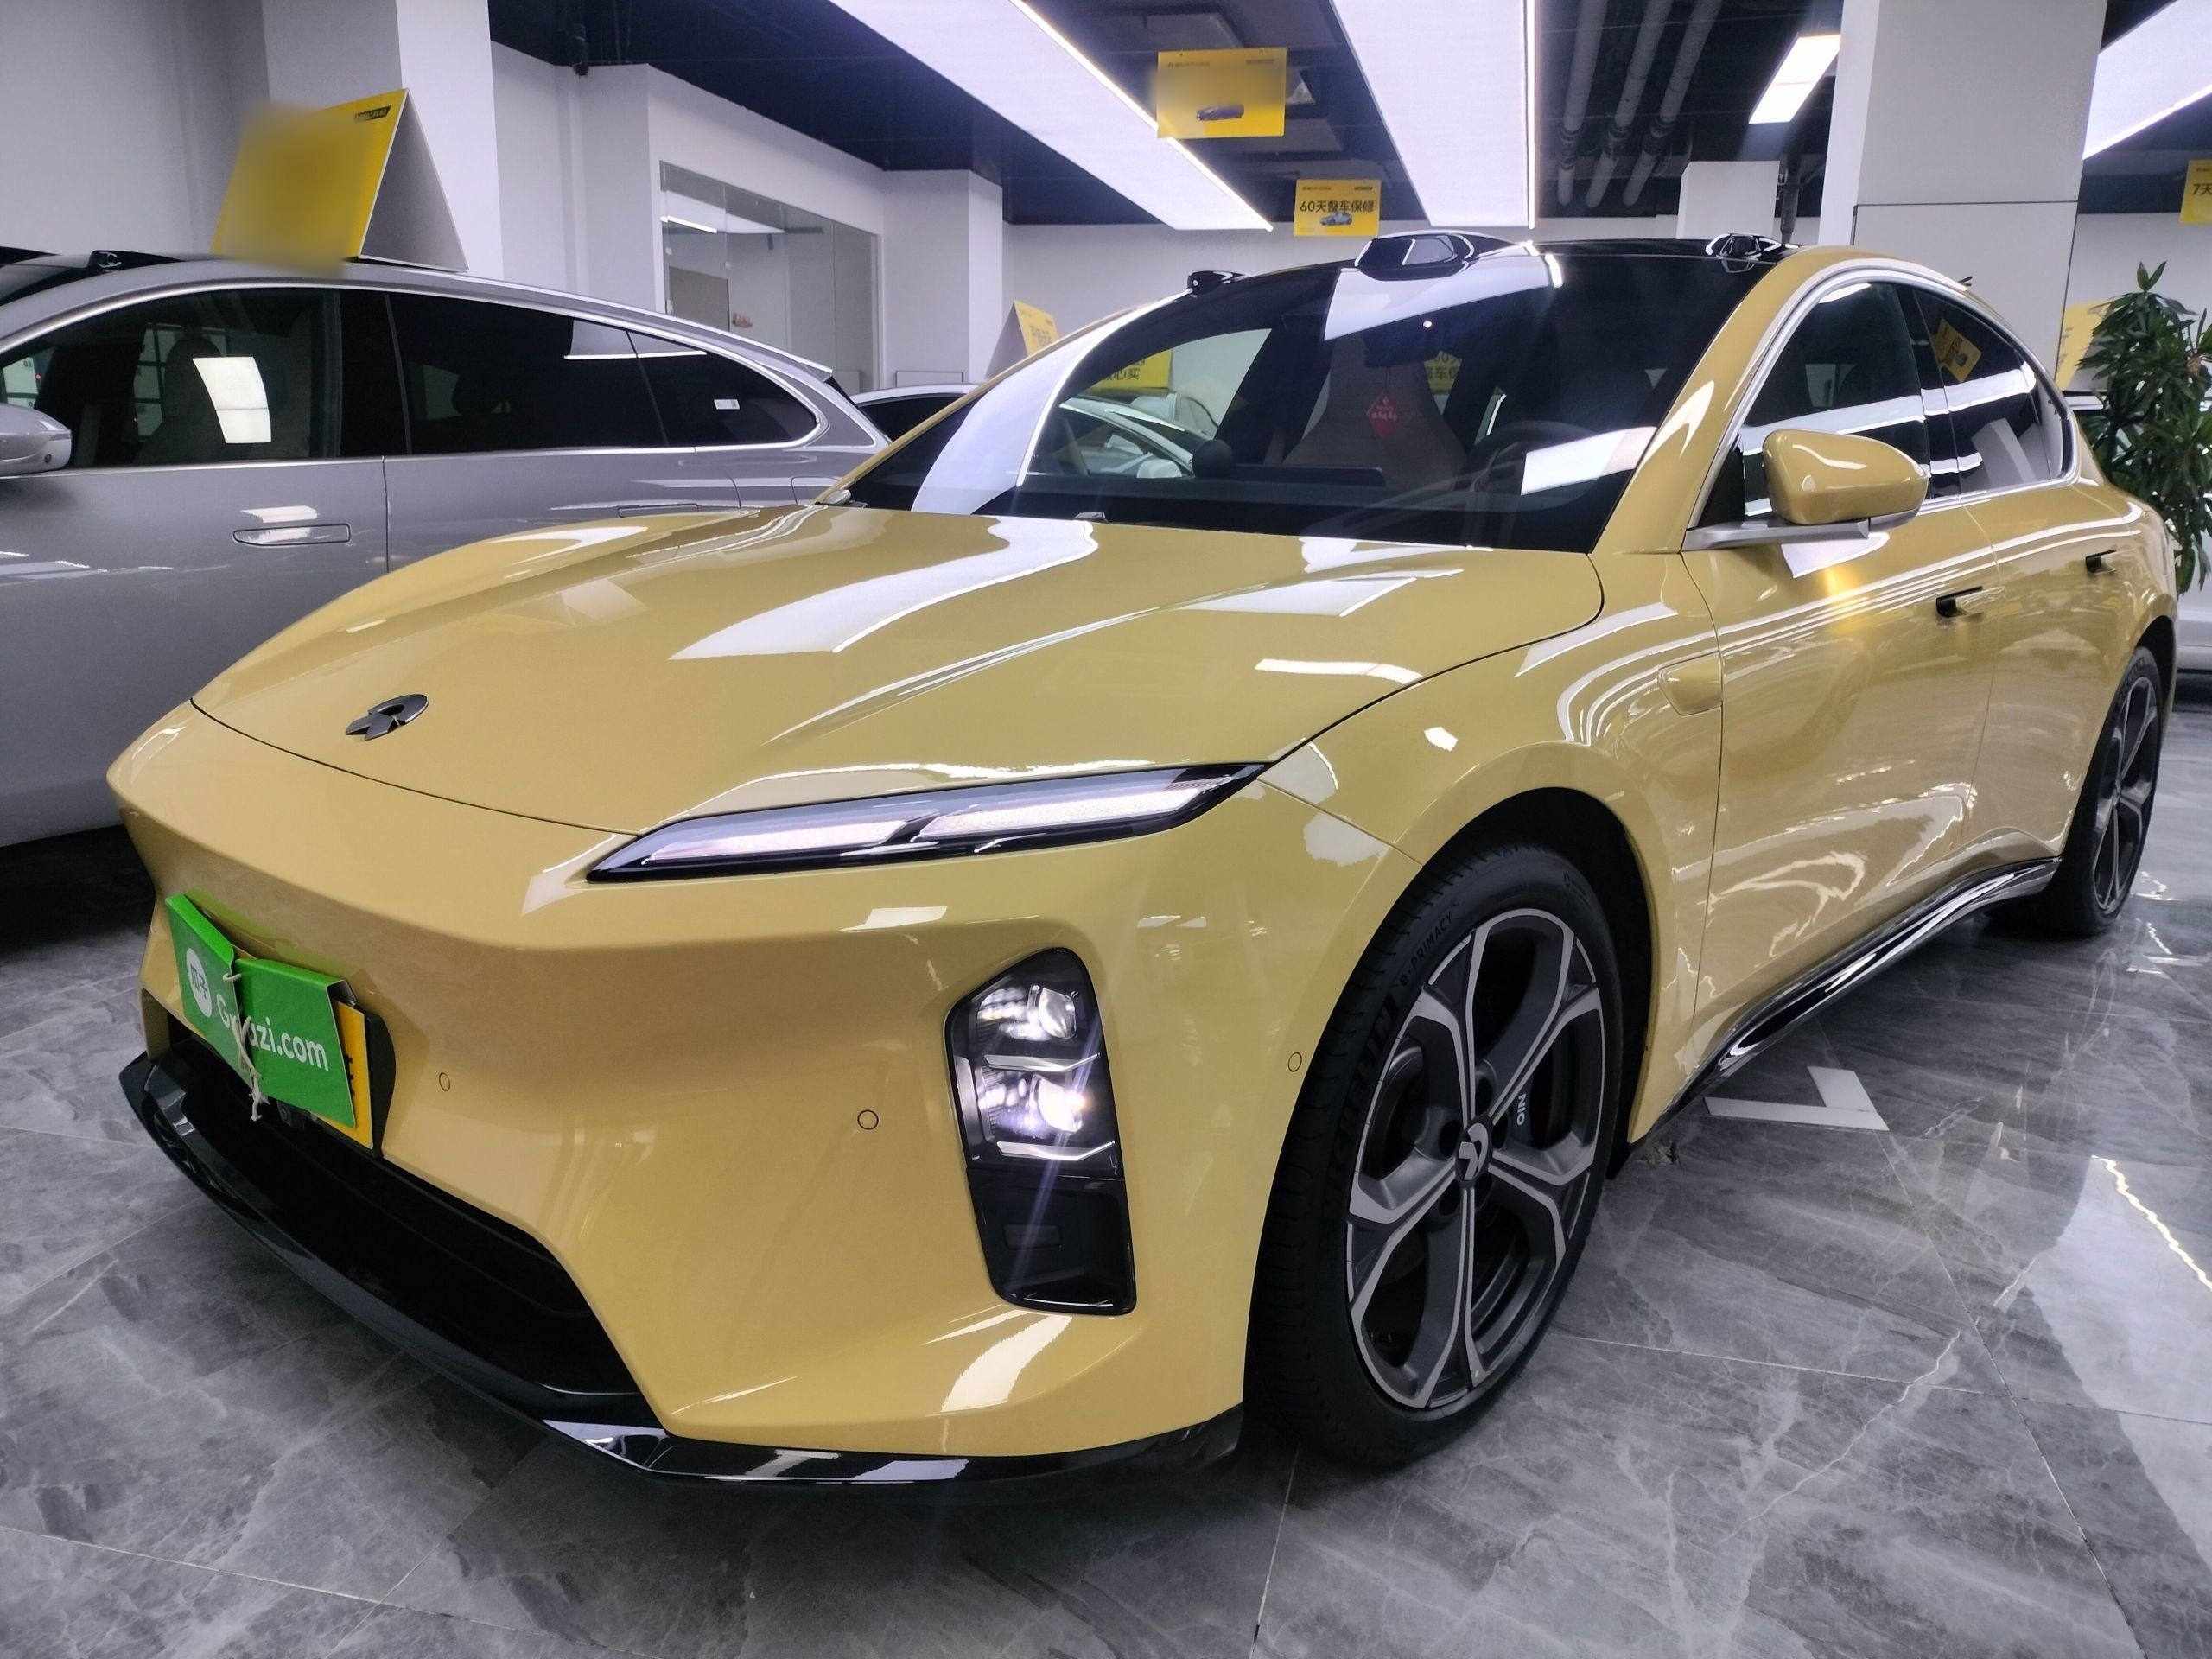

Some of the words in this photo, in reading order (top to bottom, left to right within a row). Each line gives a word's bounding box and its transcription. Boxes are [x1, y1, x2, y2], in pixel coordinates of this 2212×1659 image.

[1300, 200, 1375, 213] 60天整车保修
[216, 993, 329, 1071] Gazi.com
[1516, 1092, 1527, 1127] NIO
